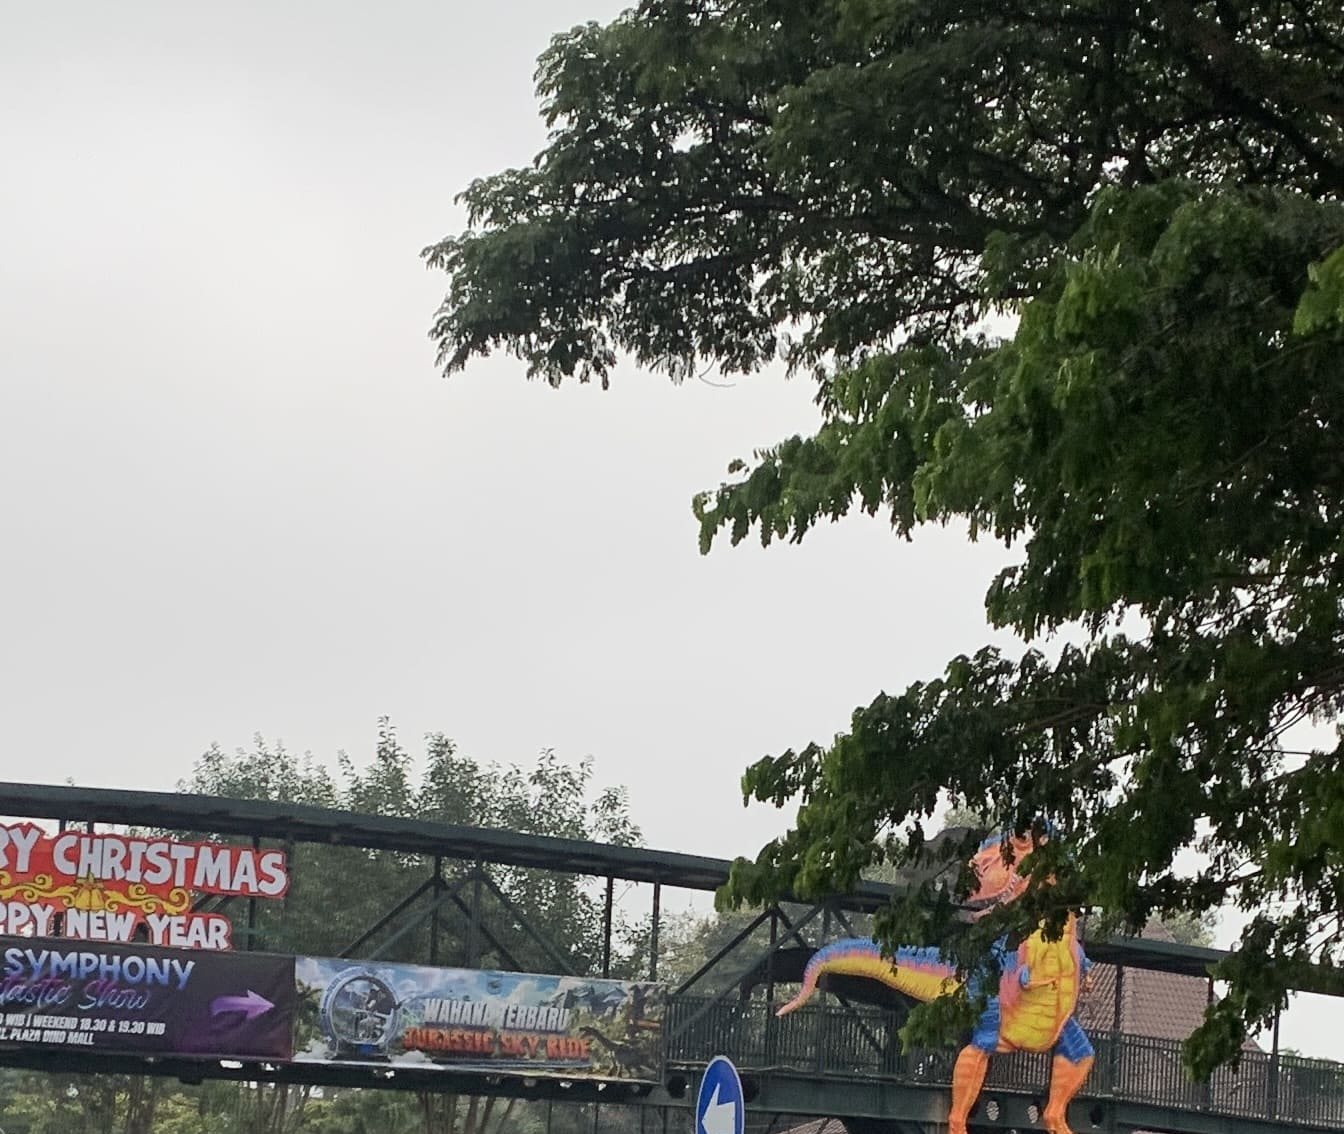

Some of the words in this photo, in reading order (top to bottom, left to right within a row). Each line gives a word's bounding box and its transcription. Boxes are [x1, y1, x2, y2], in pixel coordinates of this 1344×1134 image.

[53, 834, 287, 894] CHRISTMAS
[67, 909, 136, 941] NEW
[149, 914, 229, 949] YEAR
[4, 948, 195, 991] SYMPHONY
[78, 977, 151, 1010] Show
[5, 1013, 26, 1026] WIB
[33, 1015, 78, 1029] WEEKEND
[79, 1018, 106, 1031] 18.30
[107, 1020, 116, 1032] &
[118, 1021, 145, 1034] 19.30
[146, 1023, 166, 1035] WIB
[424, 999, 495, 1027] WAHANA
[498, 1004, 570, 1032] TERBARU
[10, 1028, 41, 1042] PLAZA
[42, 1031, 66, 1043] DINO
[67, 1032, 95, 1045] MALL
[403, 1028, 493, 1053] JURASSIC
[499, 1032, 538, 1056] SKY
[546, 1036, 591, 1060] RIDE
